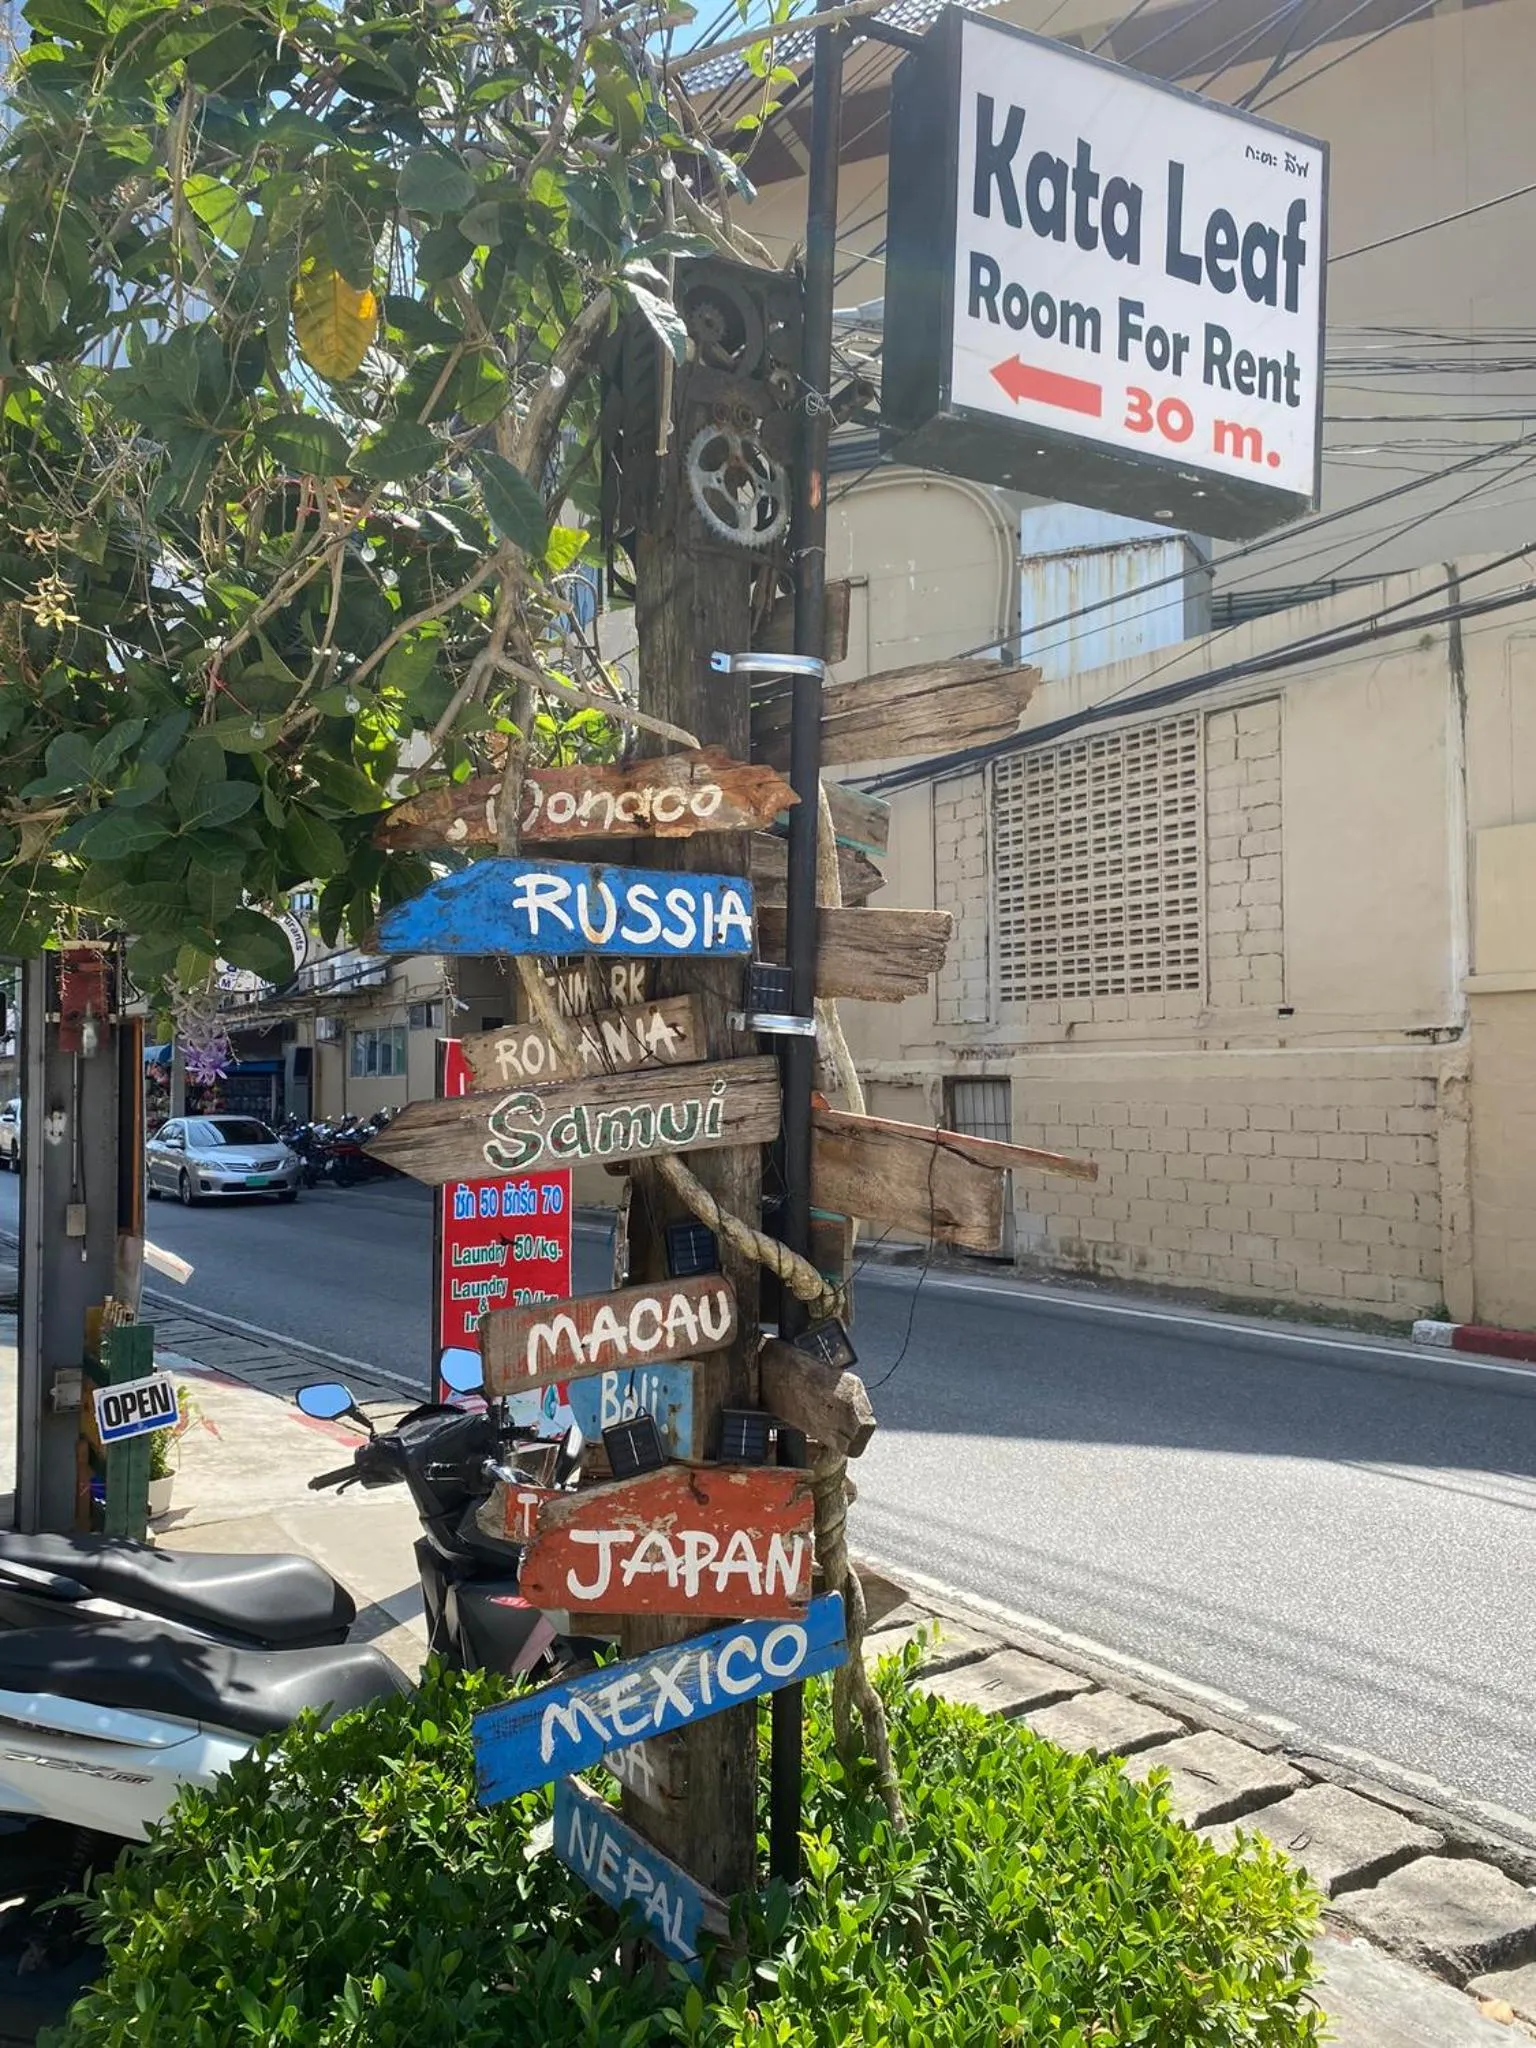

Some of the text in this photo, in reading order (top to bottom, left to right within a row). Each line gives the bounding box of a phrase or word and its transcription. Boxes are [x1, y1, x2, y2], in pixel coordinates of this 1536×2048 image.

[973, 92, 1307, 313] Kata Leaf
[968, 251, 1301, 407] Room For Rent
[1124, 386, 1281, 468] 30 m.
[512, 873, 753, 949] RUSSIA
[484, 1080, 727, 1170] Samui
[479, 1187, 498, 1217] 50
[542, 1185, 563, 1214] 70
[452, 1240, 509, 1266] Laundry
[452, 1275, 509, 1300] Laundry
[479, 1297, 490, 1313] &
[527, 1290, 731, 1376] MACAU
[103, 1382, 170, 1427] OPEN
[601, 1370, 659, 1428] Bali
[566, 1529, 803, 1601] JAPAN
[540, 1624, 808, 1764] MEXICO
[568, 1806, 699, 1962] NEPAL
